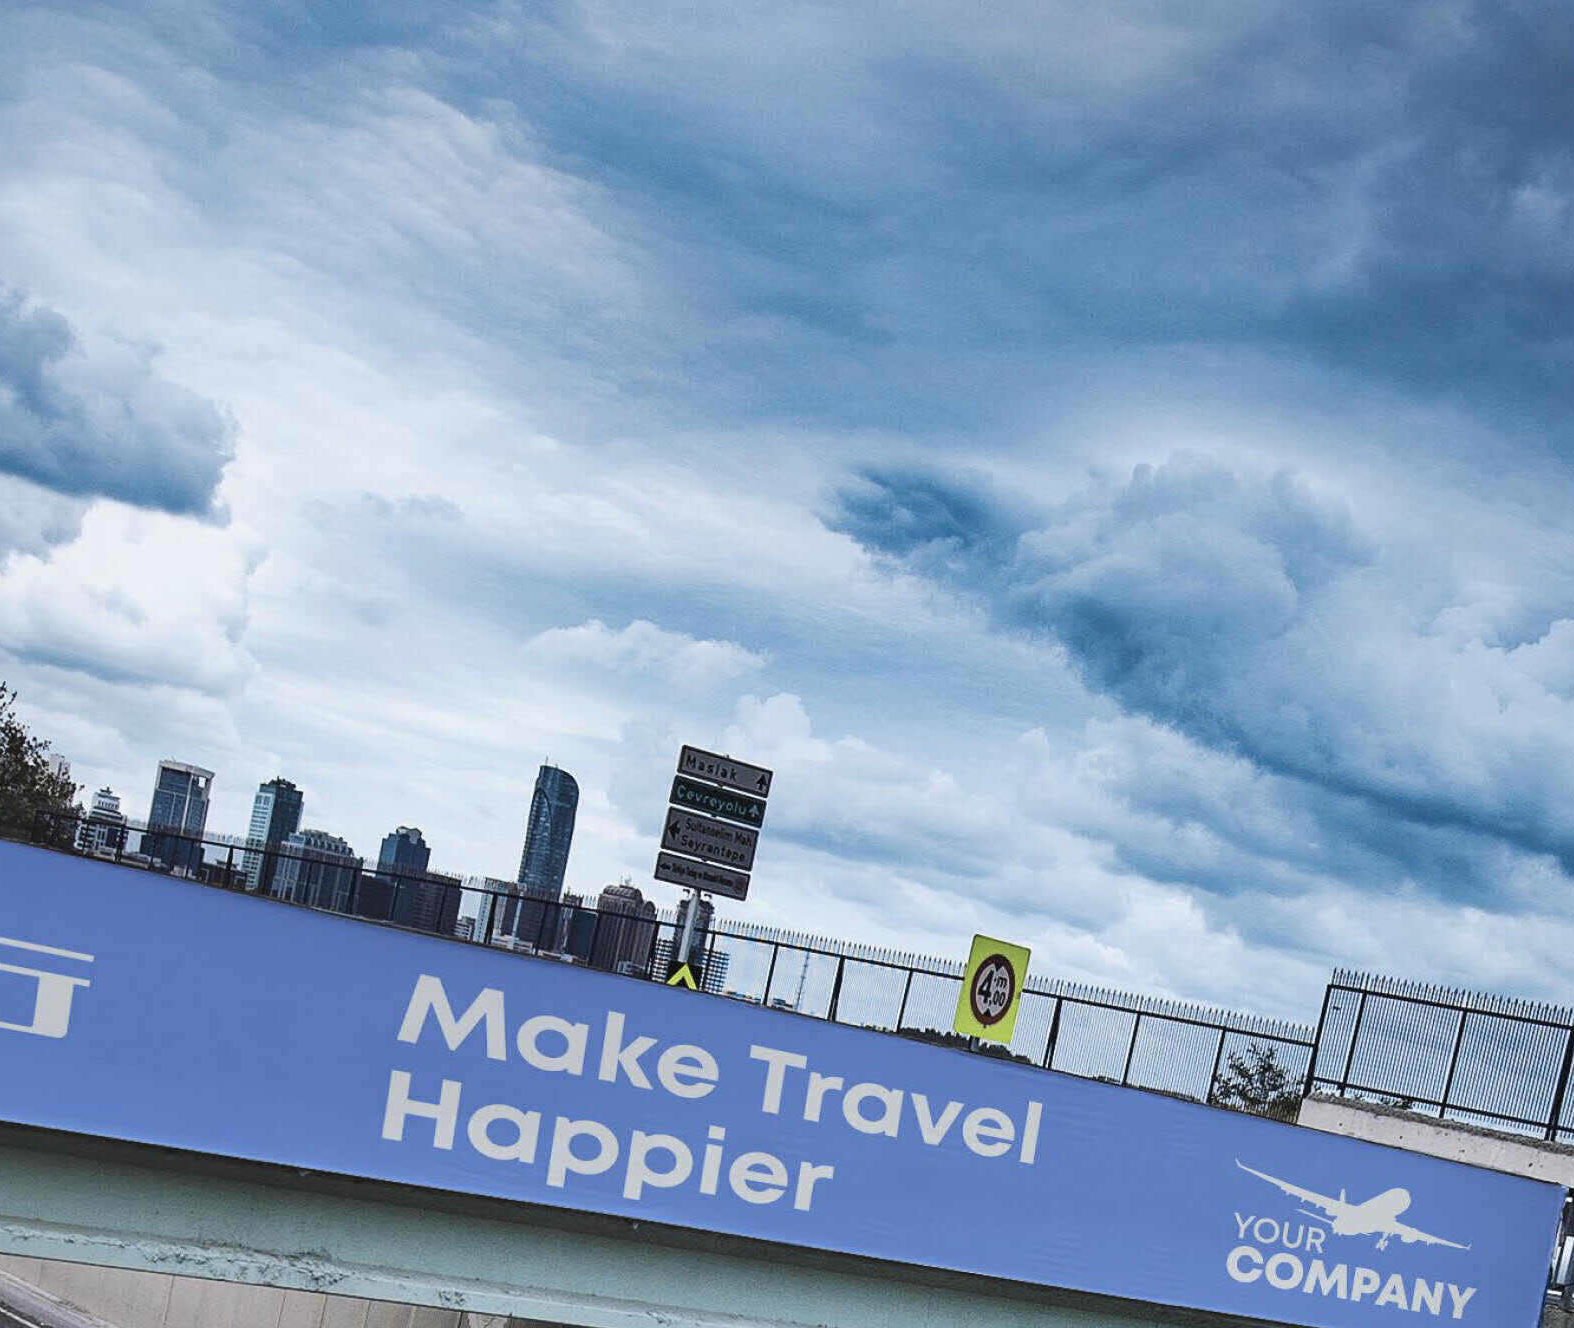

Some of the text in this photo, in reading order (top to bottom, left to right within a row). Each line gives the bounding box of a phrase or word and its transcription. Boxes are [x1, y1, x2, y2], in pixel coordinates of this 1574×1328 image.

[685, 755, 737, 781] Maslak
[681, 835, 745, 861] Seyrantepe
[397, 974, 1042, 1164] Make Travel
[381, 1070, 834, 1211] Happier
[1233, 1212, 1326, 1253] YOUR
[1226, 1245, 1476, 1320] COMPANY
